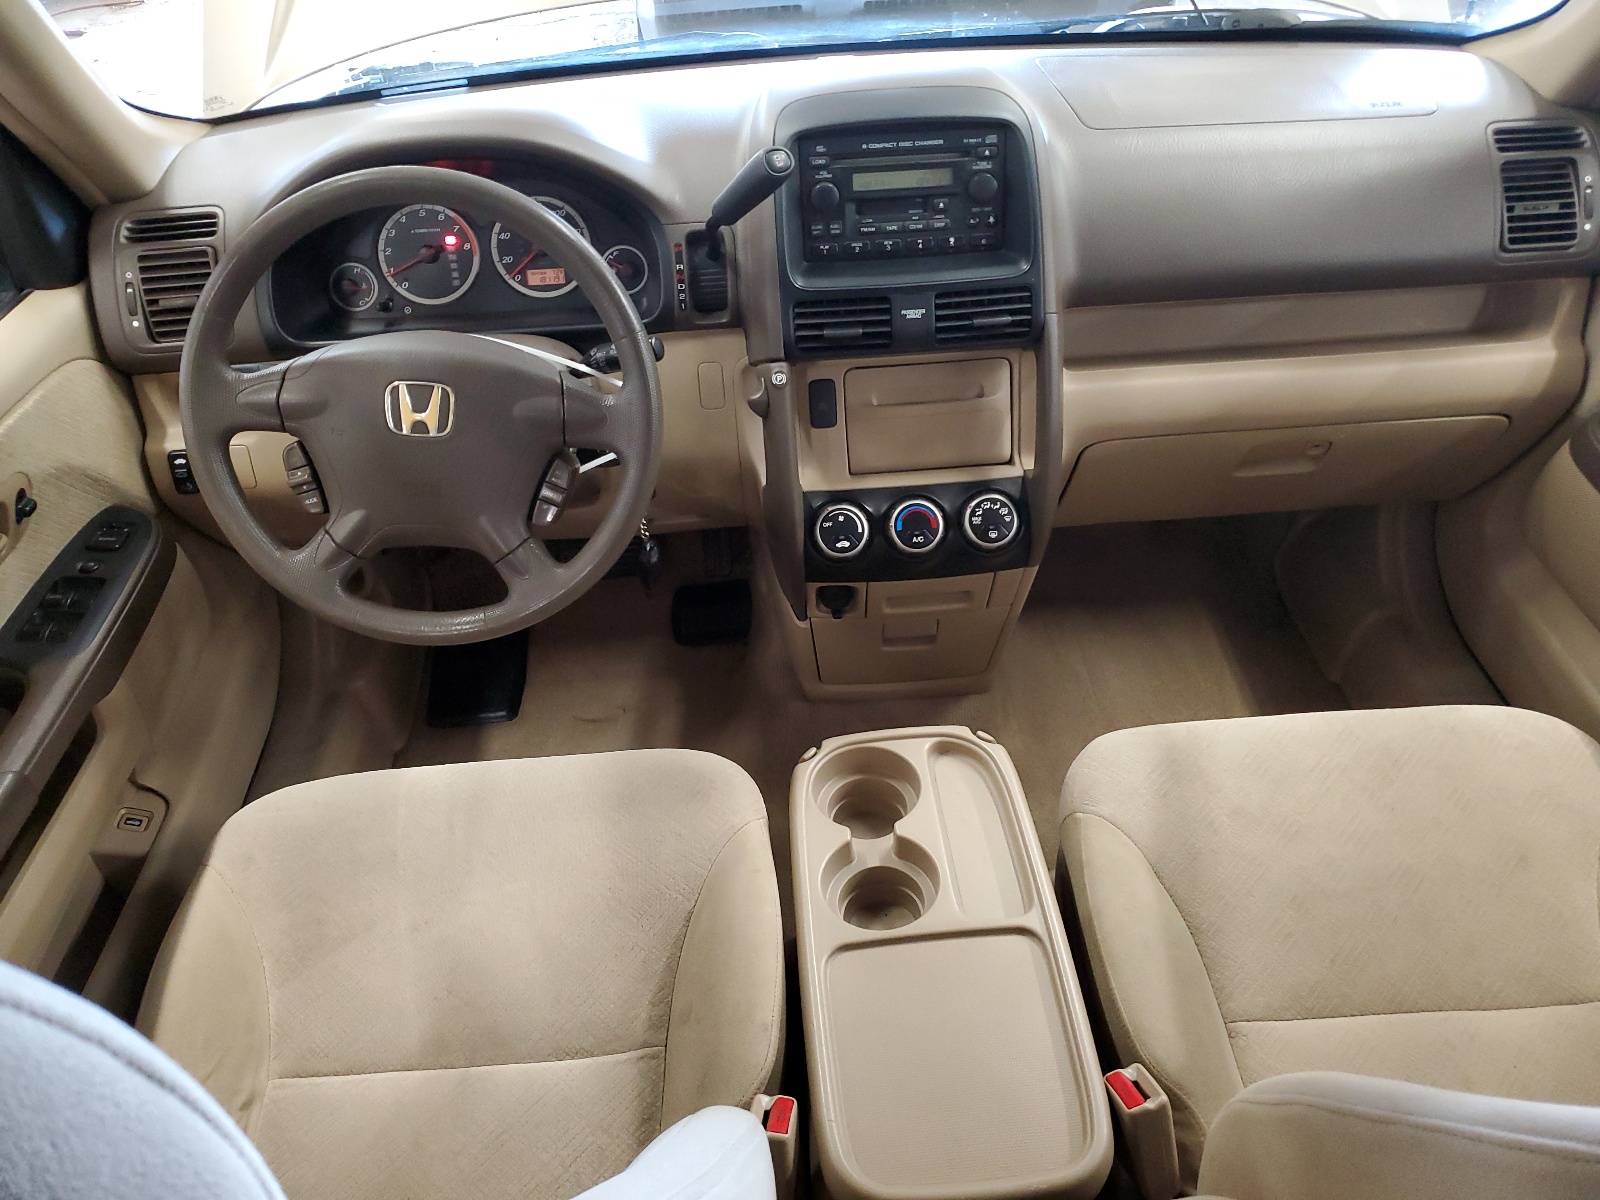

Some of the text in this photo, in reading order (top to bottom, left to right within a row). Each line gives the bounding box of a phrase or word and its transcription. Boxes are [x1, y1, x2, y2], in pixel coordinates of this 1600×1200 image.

[437, 213, 445, 221] 6
[499, 232, 511, 240] 40
[502, 256, 513, 264] 20
